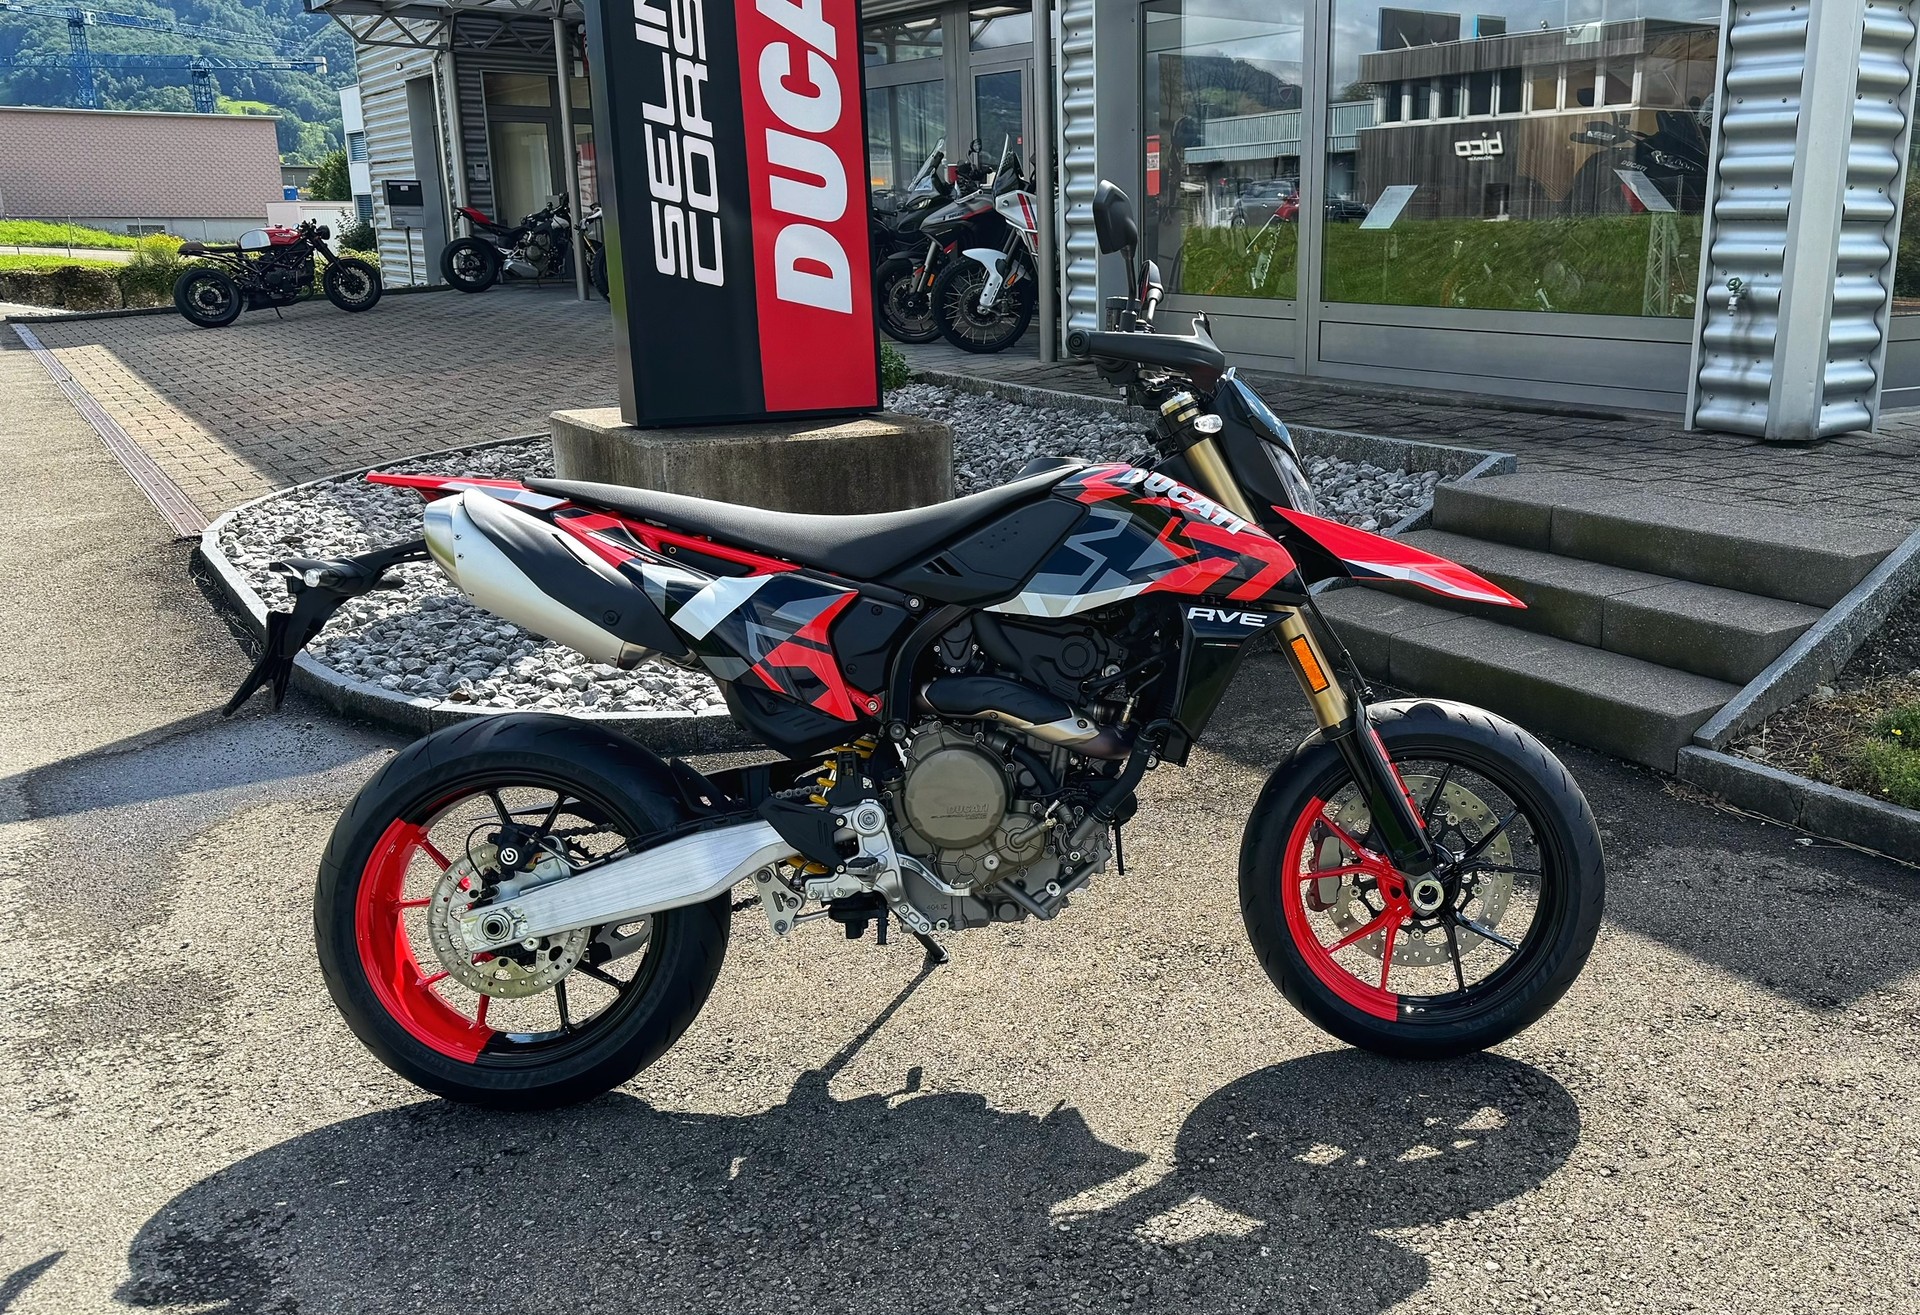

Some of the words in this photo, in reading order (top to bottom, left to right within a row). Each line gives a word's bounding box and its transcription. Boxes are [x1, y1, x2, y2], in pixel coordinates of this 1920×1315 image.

[1620, 159, 1648, 173] DUCATI
[1117, 467, 1249, 535] DUCATI
[1187, 607, 1268, 628] RVE
